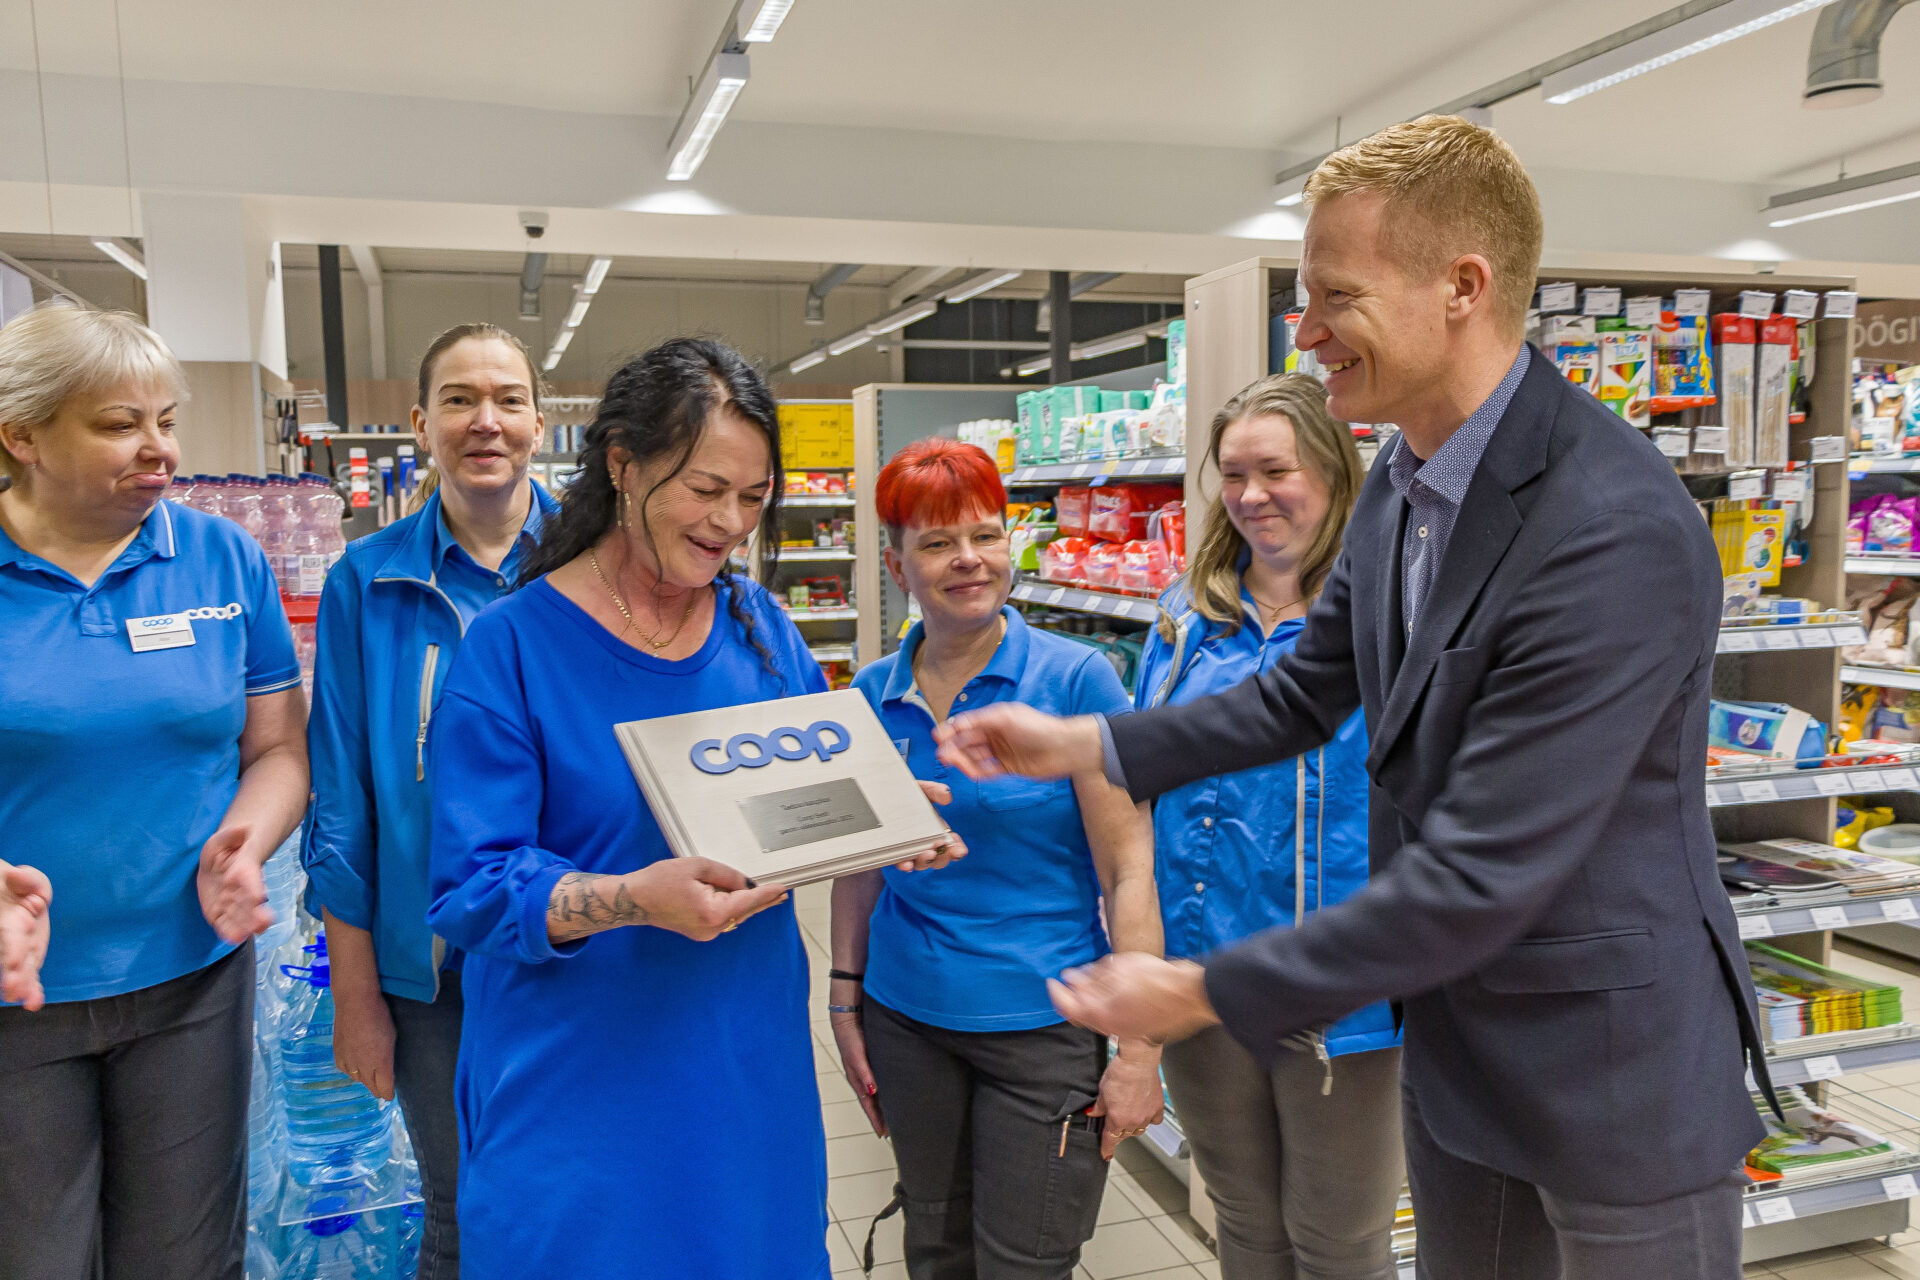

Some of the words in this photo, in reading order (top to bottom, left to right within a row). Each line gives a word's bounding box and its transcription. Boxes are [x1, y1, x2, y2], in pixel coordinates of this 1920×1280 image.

[186, 602, 242, 620] coop
[143, 617, 174, 627] coop
[690, 720, 851, 774] coop
